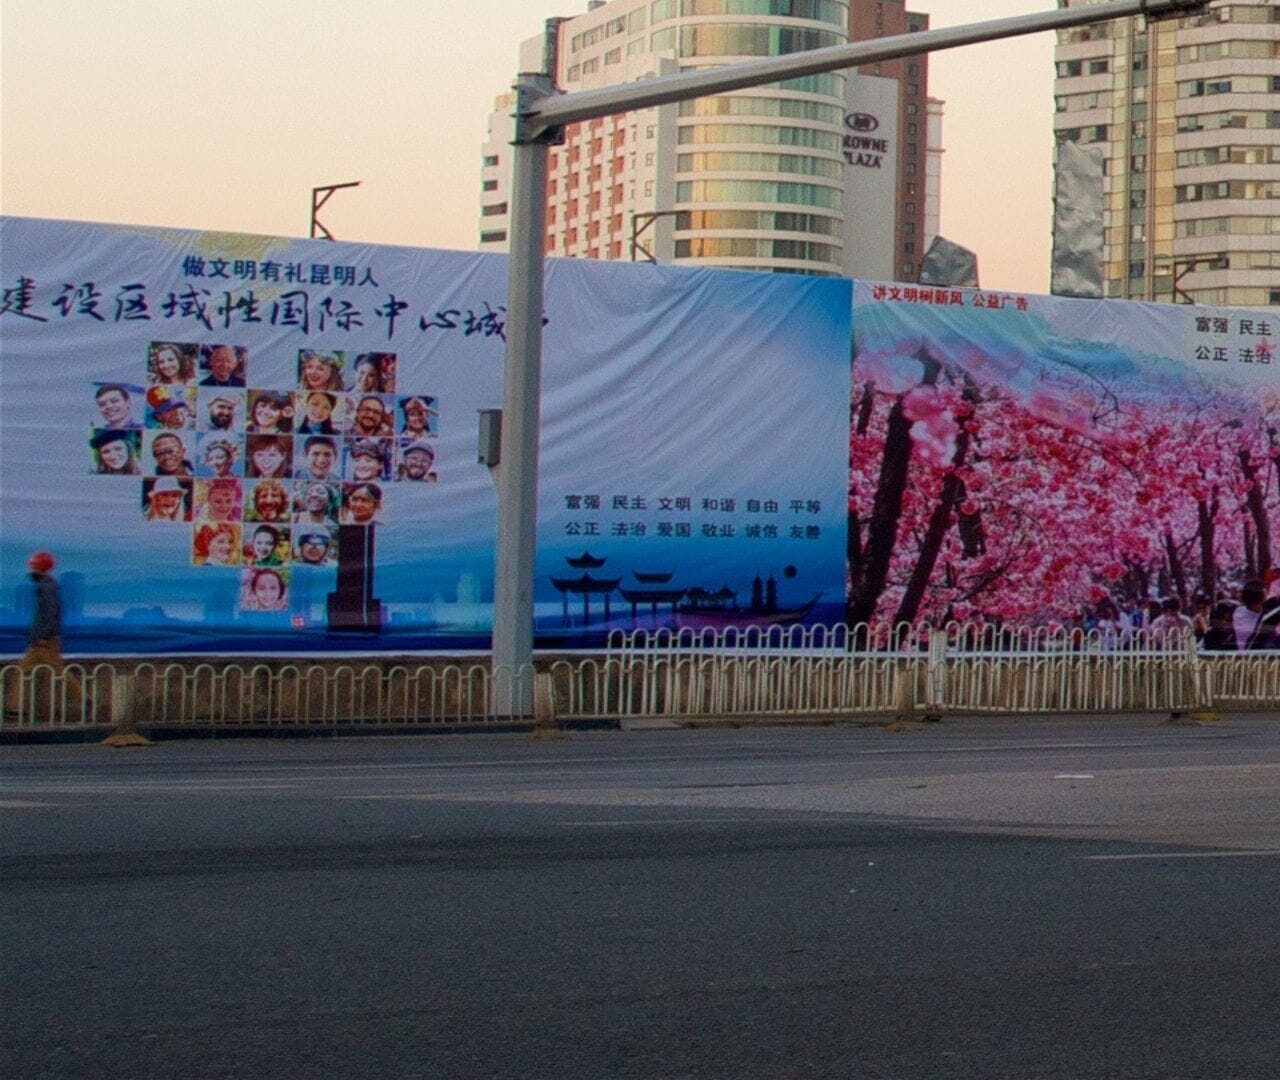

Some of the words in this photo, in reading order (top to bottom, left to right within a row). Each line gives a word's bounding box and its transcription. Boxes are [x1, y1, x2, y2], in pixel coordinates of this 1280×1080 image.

[843, 134, 888, 153] ROWNE
[182, 255, 379, 288] 做文明有礼昆明人
[0, 274, 549, 343] 建设区域性国际中心城
[873, 285, 964, 307] 讲文明树新风
[972, 293, 1029, 312] 公益广告
[1195, 317, 1228, 333] 富强
[1239, 319, 1272, 336] 民主
[1195, 345, 1228, 362] 公正
[1239, 348, 1271, 364] 法治
[565, 494, 600, 510] 富强
[612, 495, 647, 511] 民主
[658, 496, 691, 512] 文明
[702, 497, 736, 513] 和谐
[747, 499, 779, 513] 自由
[789, 499, 822, 515] 平等
[565, 522, 600, 536] 公正
[612, 522, 647, 537] 法治
[657, 522, 691, 538] 爱国
[702, 523, 735, 538] 敬业
[745, 524, 778, 539] 诚信
[789, 525, 820, 540] 友善
